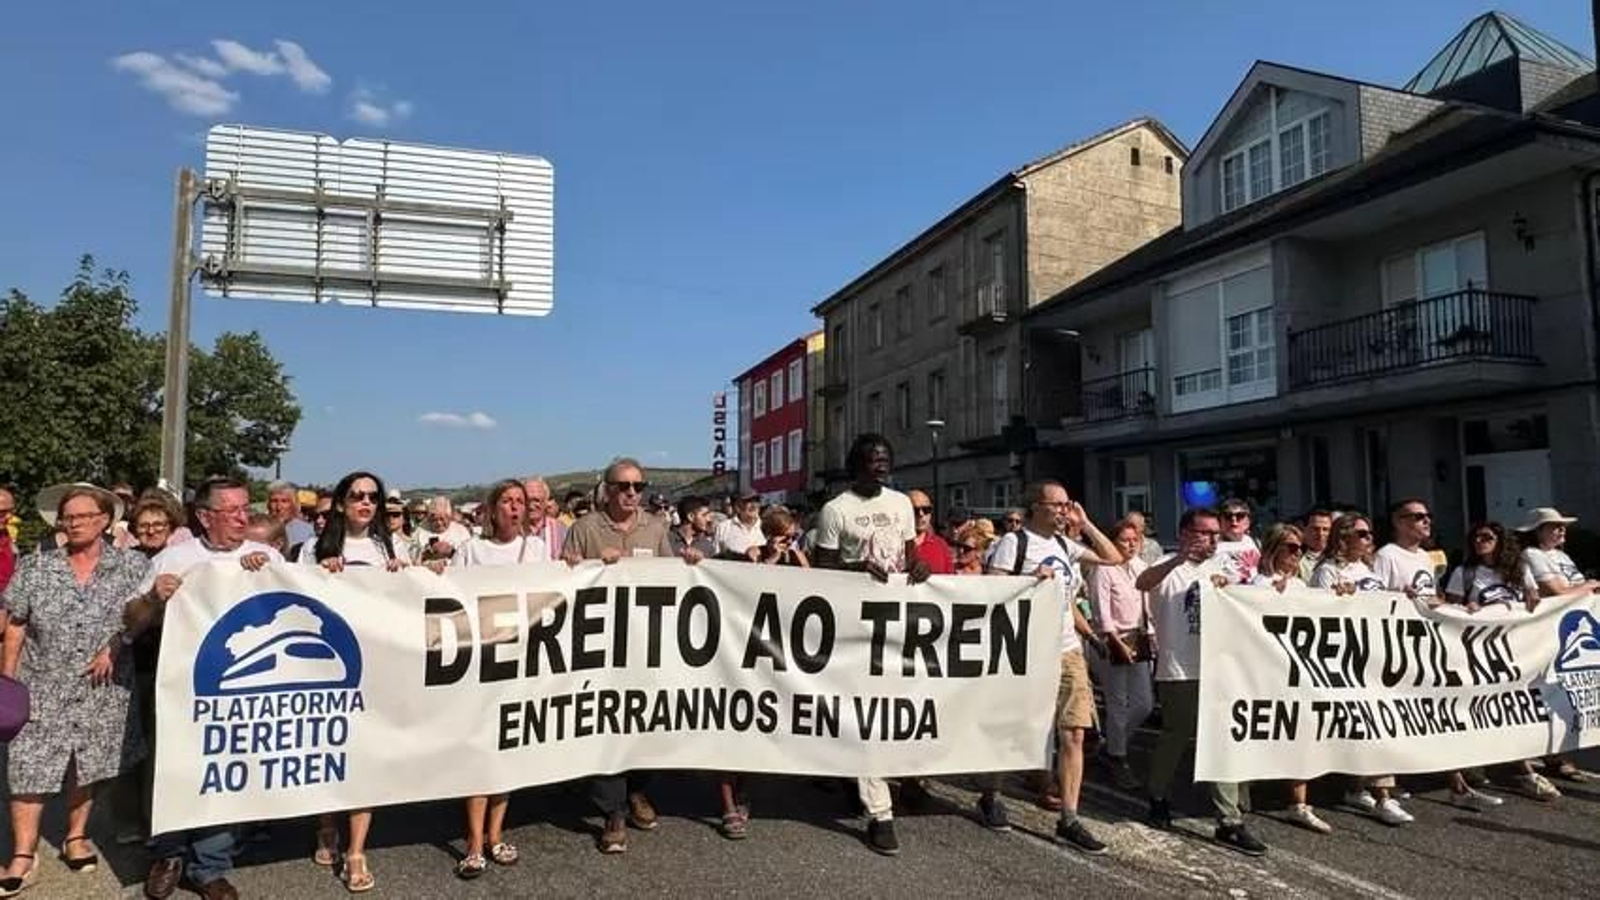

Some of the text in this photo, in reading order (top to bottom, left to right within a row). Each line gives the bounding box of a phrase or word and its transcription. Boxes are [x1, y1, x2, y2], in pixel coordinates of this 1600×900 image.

[424, 586, 1031, 686] DEREITO AO TREN
[1262, 614, 1370, 688] TREN
[1381, 600, 1463, 687] ÚTIL
[193, 691, 366, 723] PLATAFORMA
[499, 680, 938, 750] ENTÉRRANNOS EN VIDA
[1231, 687, 1550, 743] SEN TREN O RURAL MORRE
[202, 717, 348, 756] DEREITO
[199, 752, 347, 796] AO TREN
